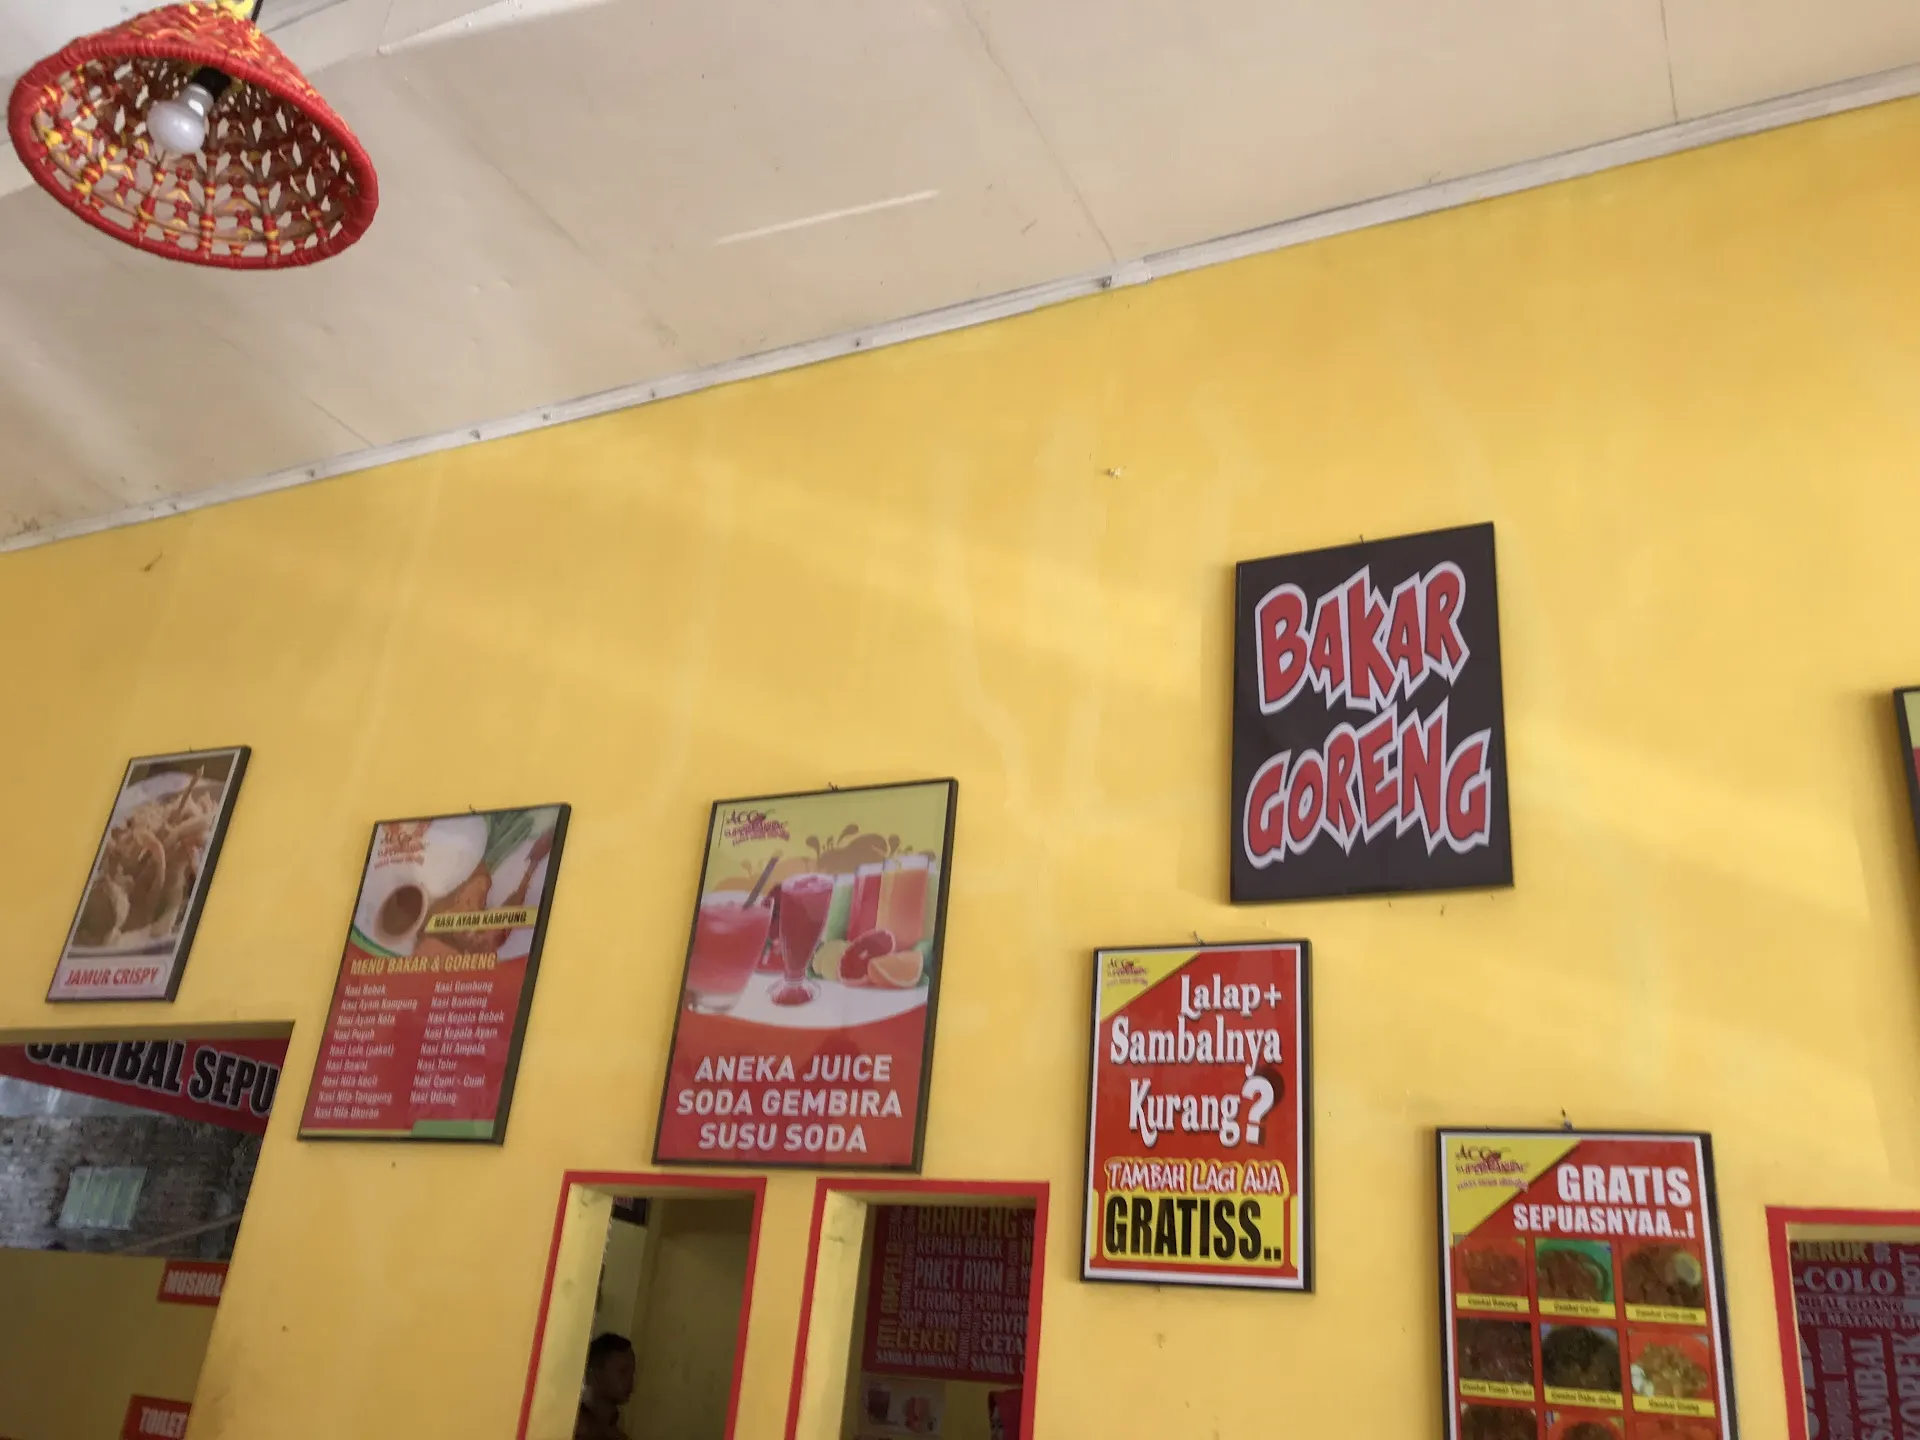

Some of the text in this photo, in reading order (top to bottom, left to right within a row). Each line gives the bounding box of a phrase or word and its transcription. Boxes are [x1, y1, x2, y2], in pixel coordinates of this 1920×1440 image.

[1254, 560, 1470, 715] BAKAR
[1243, 695, 1491, 869] GORENG
[434, 911, 526, 928] NASI AYAM KAMPUNG
[351, 952, 497, 975] MENU BAKAR & GORENG
[65, 967, 159, 986] JAMUR CRISPY
[345, 985, 361, 996] Nasi
[434, 982, 452, 993] Nasi
[431, 996, 449, 1008] Nasi
[1180, 973, 1282, 1020] Lalap+
[341, 998, 417, 1012] Nasi Ayam Kampung
[337, 1015, 353, 1026] Nasi
[355, 1013, 376, 1026] Ayam
[427, 1012, 445, 1024] Nasi
[333, 1029, 350, 1041] Nasi
[424, 1027, 442, 1040] Nasi
[475, 1027, 498, 1040] Ayam
[329, 1044, 346, 1056] Nasi
[420, 1043, 438, 1055] Nasi
[1110, 1014, 1283, 1078] Sambalnya
[325, 1059, 342, 1072] Nasi
[417, 1059, 434, 1071] Nasi
[695, 1054, 893, 1083] ANEKA JUICE
[188, 1046, 280, 1116] SEPU
[321, 1074, 338, 1087] Nasi
[413, 1075, 431, 1087] Nasi
[318, 1090, 335, 1103] Nasi
[410, 1090, 427, 1103] Nasi
[676, 1088, 903, 1118] SODA GEMBIRA
[314, 1106, 331, 1119] Nasi
[1128, 1075, 1274, 1147] Kurang?
[698, 1122, 867, 1153] SUSU SODA
[1107, 1162, 1282, 1194] TAMBAH LAGI AJA
[1557, 1164, 1692, 1207] GRATIS
[1105, 1196, 1282, 1262] GRATISS..
[914, 1257, 960, 1289] PAKET
[963, 1259, 1004, 1292] AYAM
